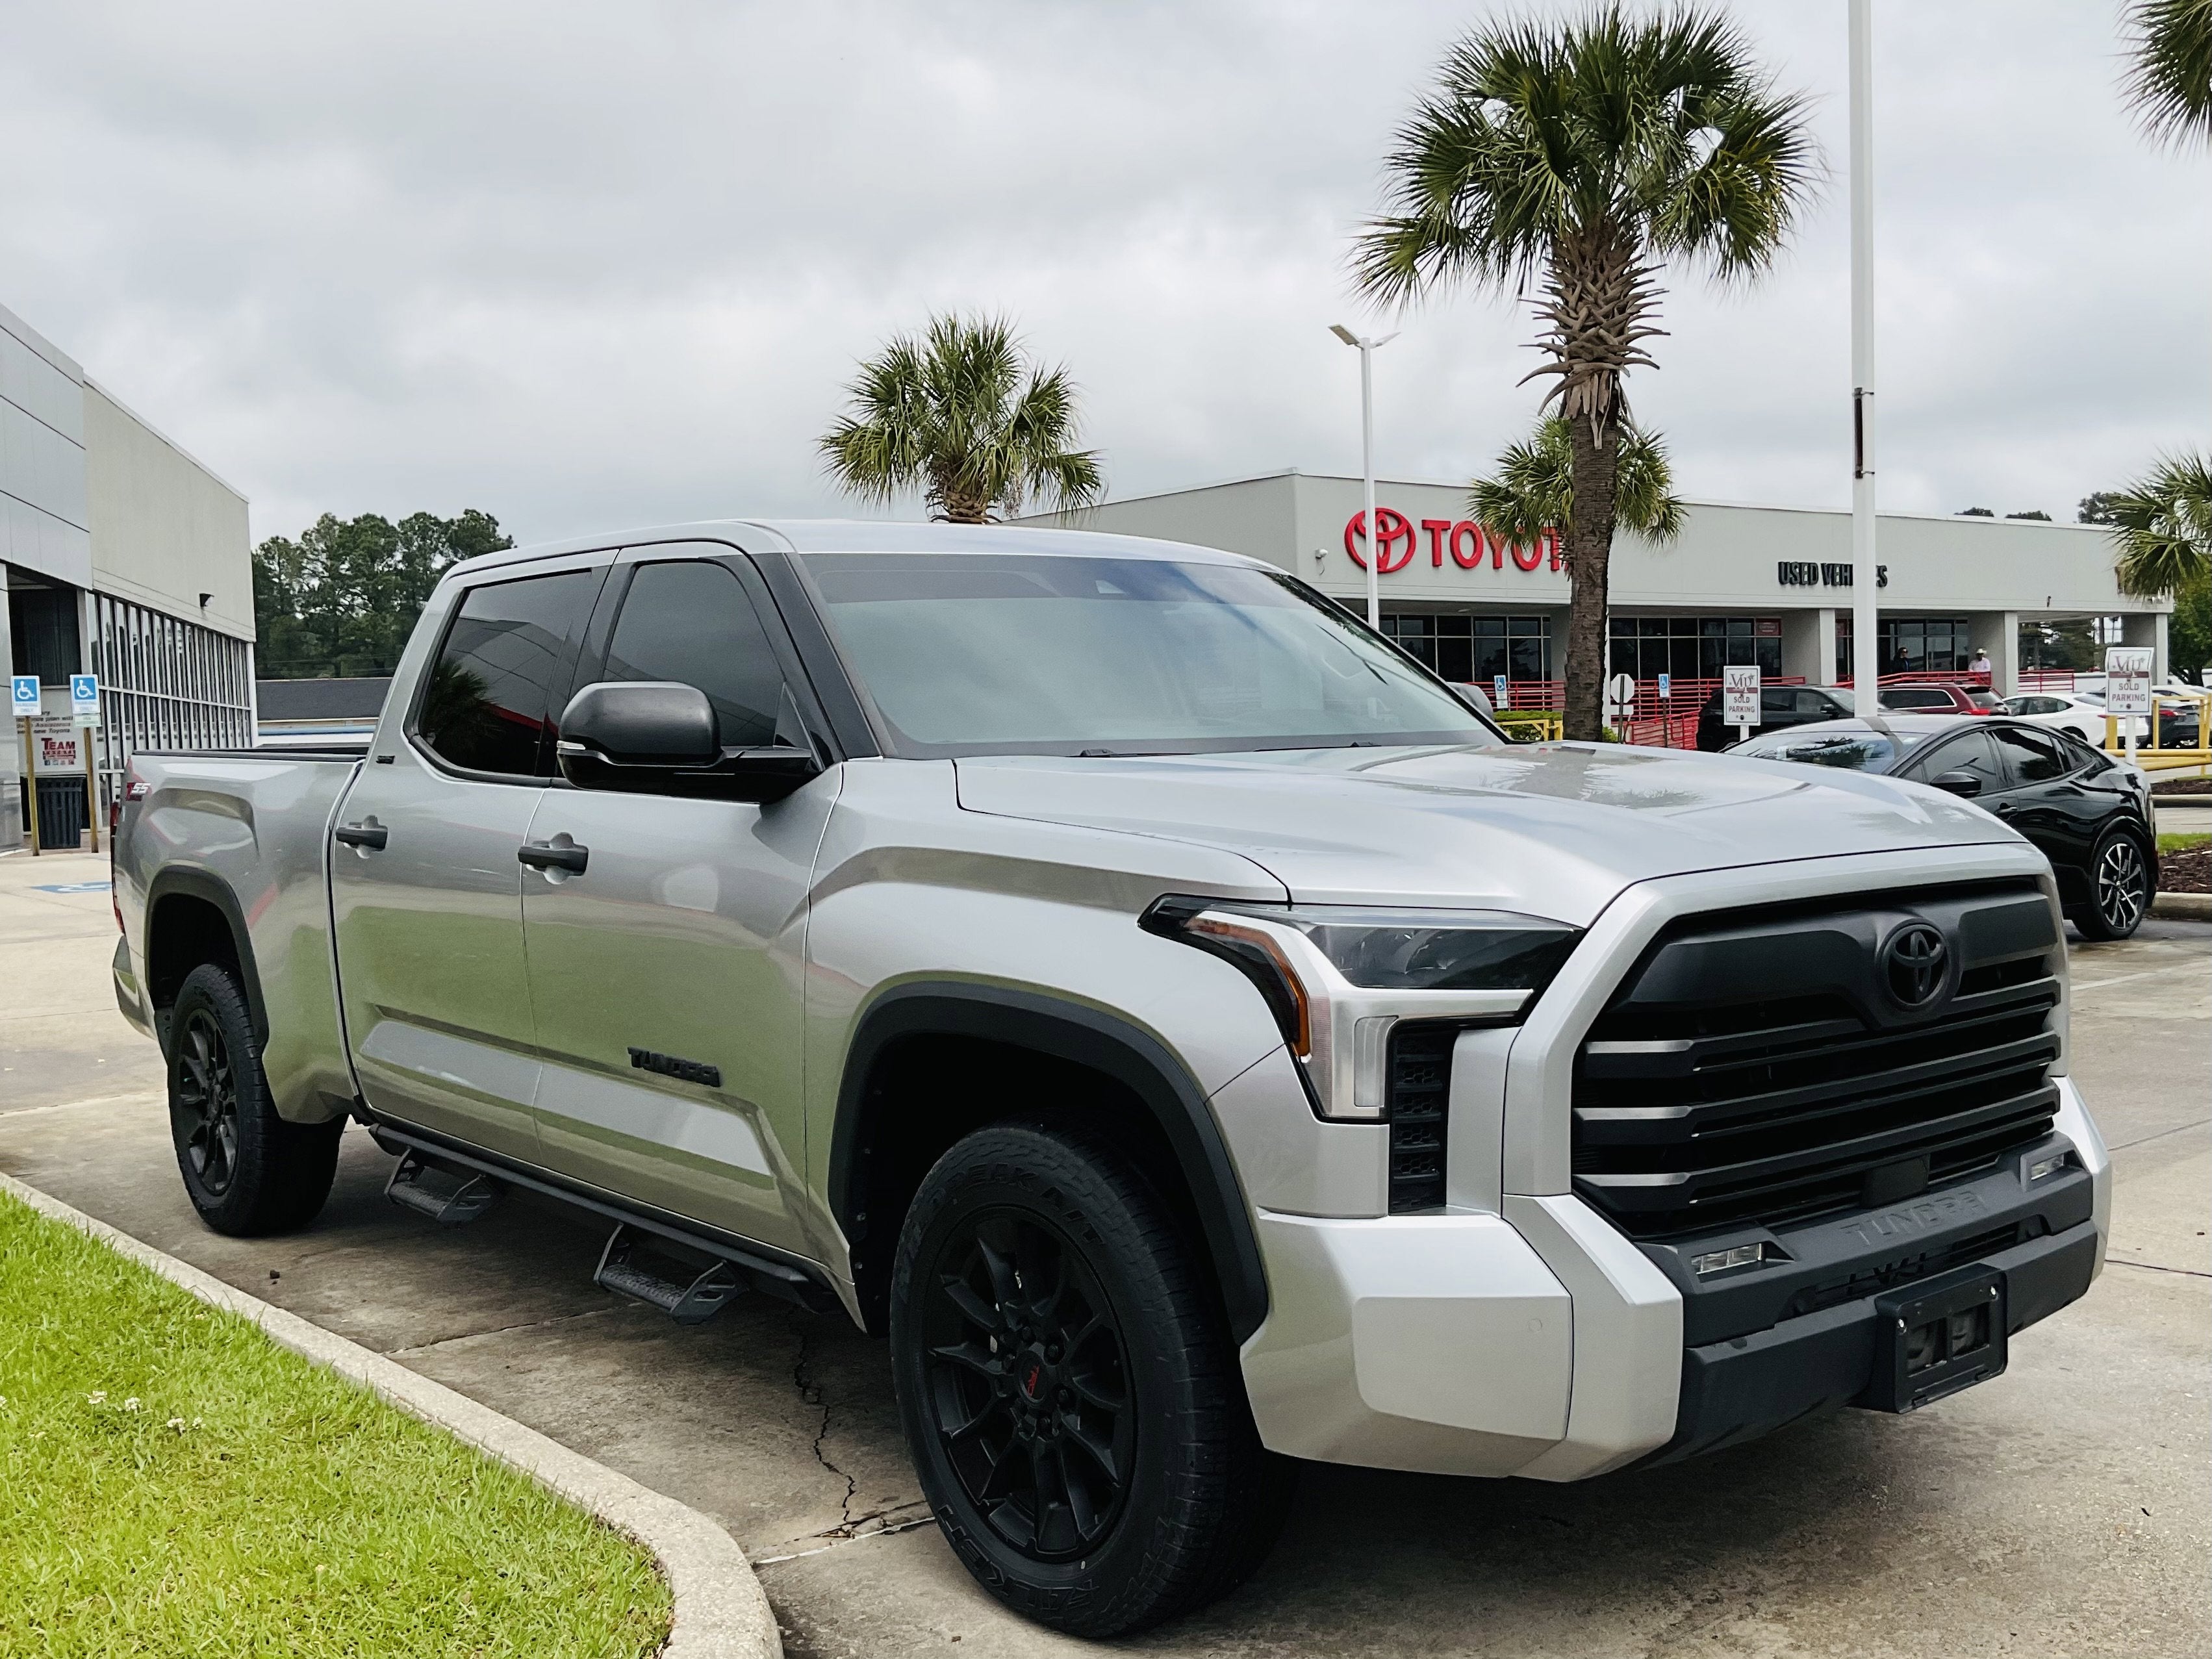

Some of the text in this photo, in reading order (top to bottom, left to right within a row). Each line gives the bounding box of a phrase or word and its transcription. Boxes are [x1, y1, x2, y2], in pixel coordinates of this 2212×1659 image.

[1421, 520, 1569, 571] TOYOT
[1778, 562, 1888, 587] USED VEHS
